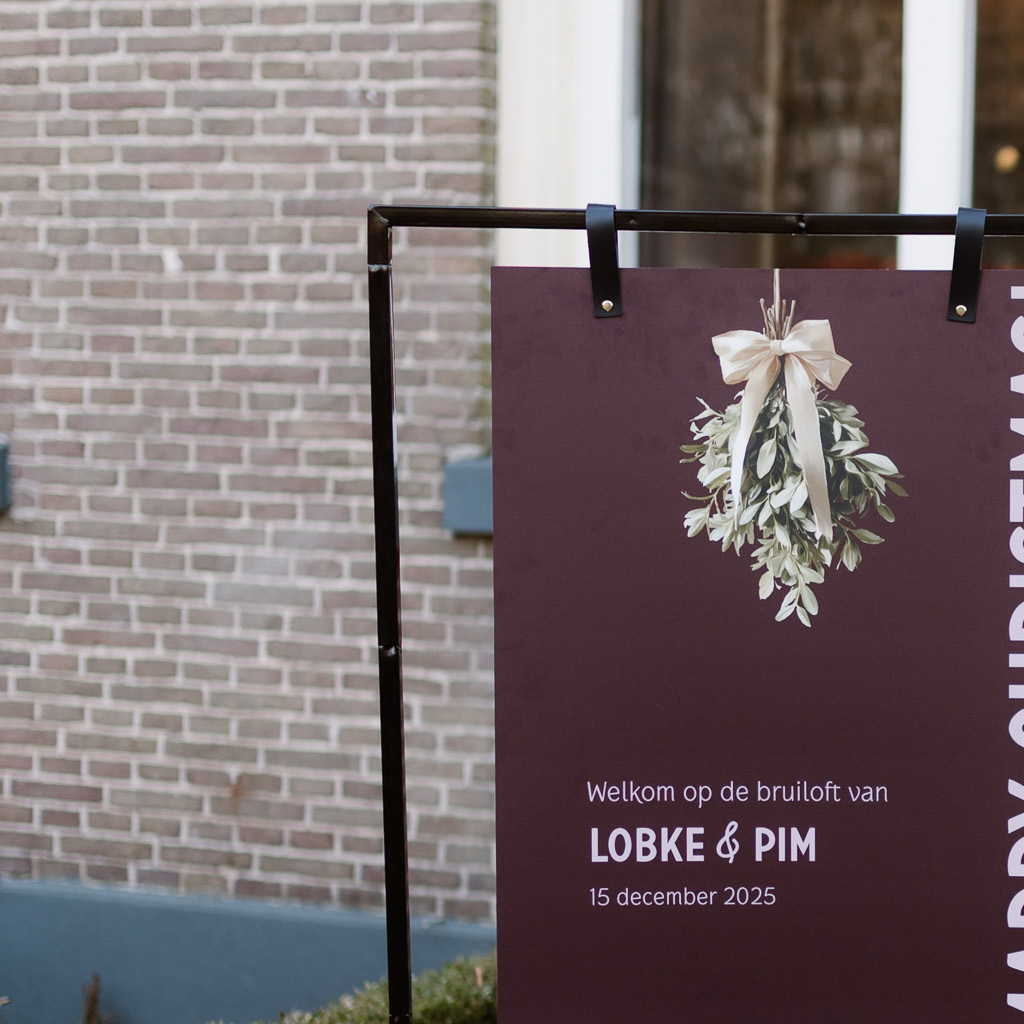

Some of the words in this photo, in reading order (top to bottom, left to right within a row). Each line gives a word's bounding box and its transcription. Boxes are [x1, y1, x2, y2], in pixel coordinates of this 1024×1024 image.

[586, 780, 675, 804] Welkom
[683, 786, 713, 809] op
[720, 780, 749, 803] de
[756, 780, 841, 803] bruiloft
[847, 784, 888, 803] van
[591, 826, 705, 863] LOBKE
[716, 820, 740, 864] &
[755, 826, 816, 862] PIM
[589, 886, 610, 906] 15
[616, 886, 717, 906] december
[723, 886, 776, 905] 2025
